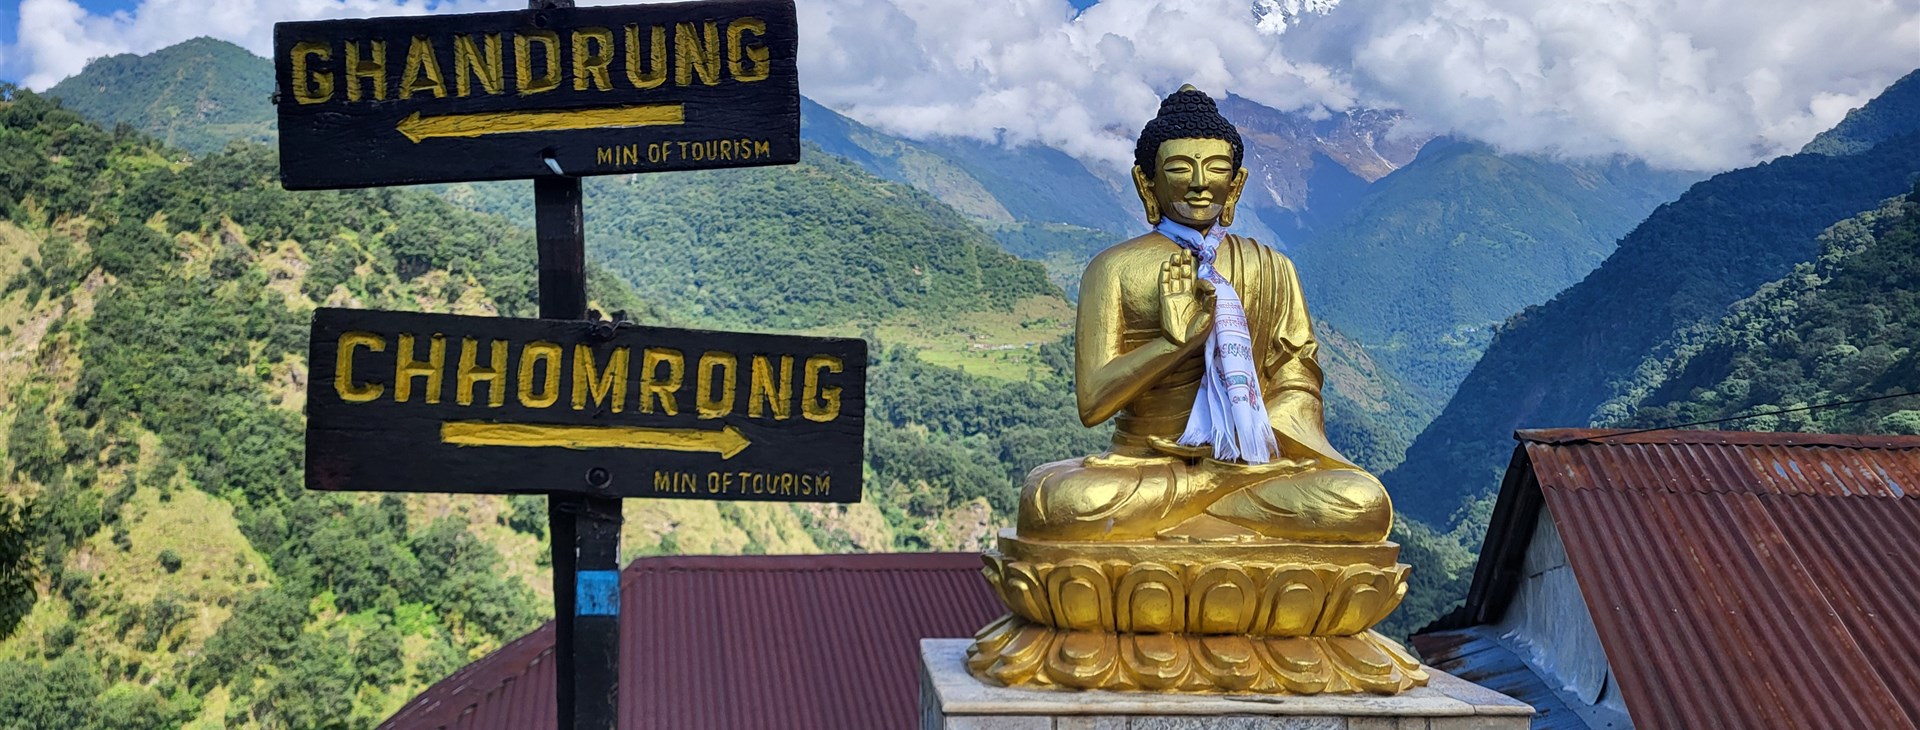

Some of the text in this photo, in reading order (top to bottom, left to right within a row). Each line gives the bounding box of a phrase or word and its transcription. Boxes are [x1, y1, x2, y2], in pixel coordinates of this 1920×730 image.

[290, 17, 771, 104] GHANDRUNG
[597, 139, 771, 166] MIN OF TOURISM
[334, 331, 844, 422] CHHOMRONG
[654, 471, 831, 496] MIN OF TOURISM
